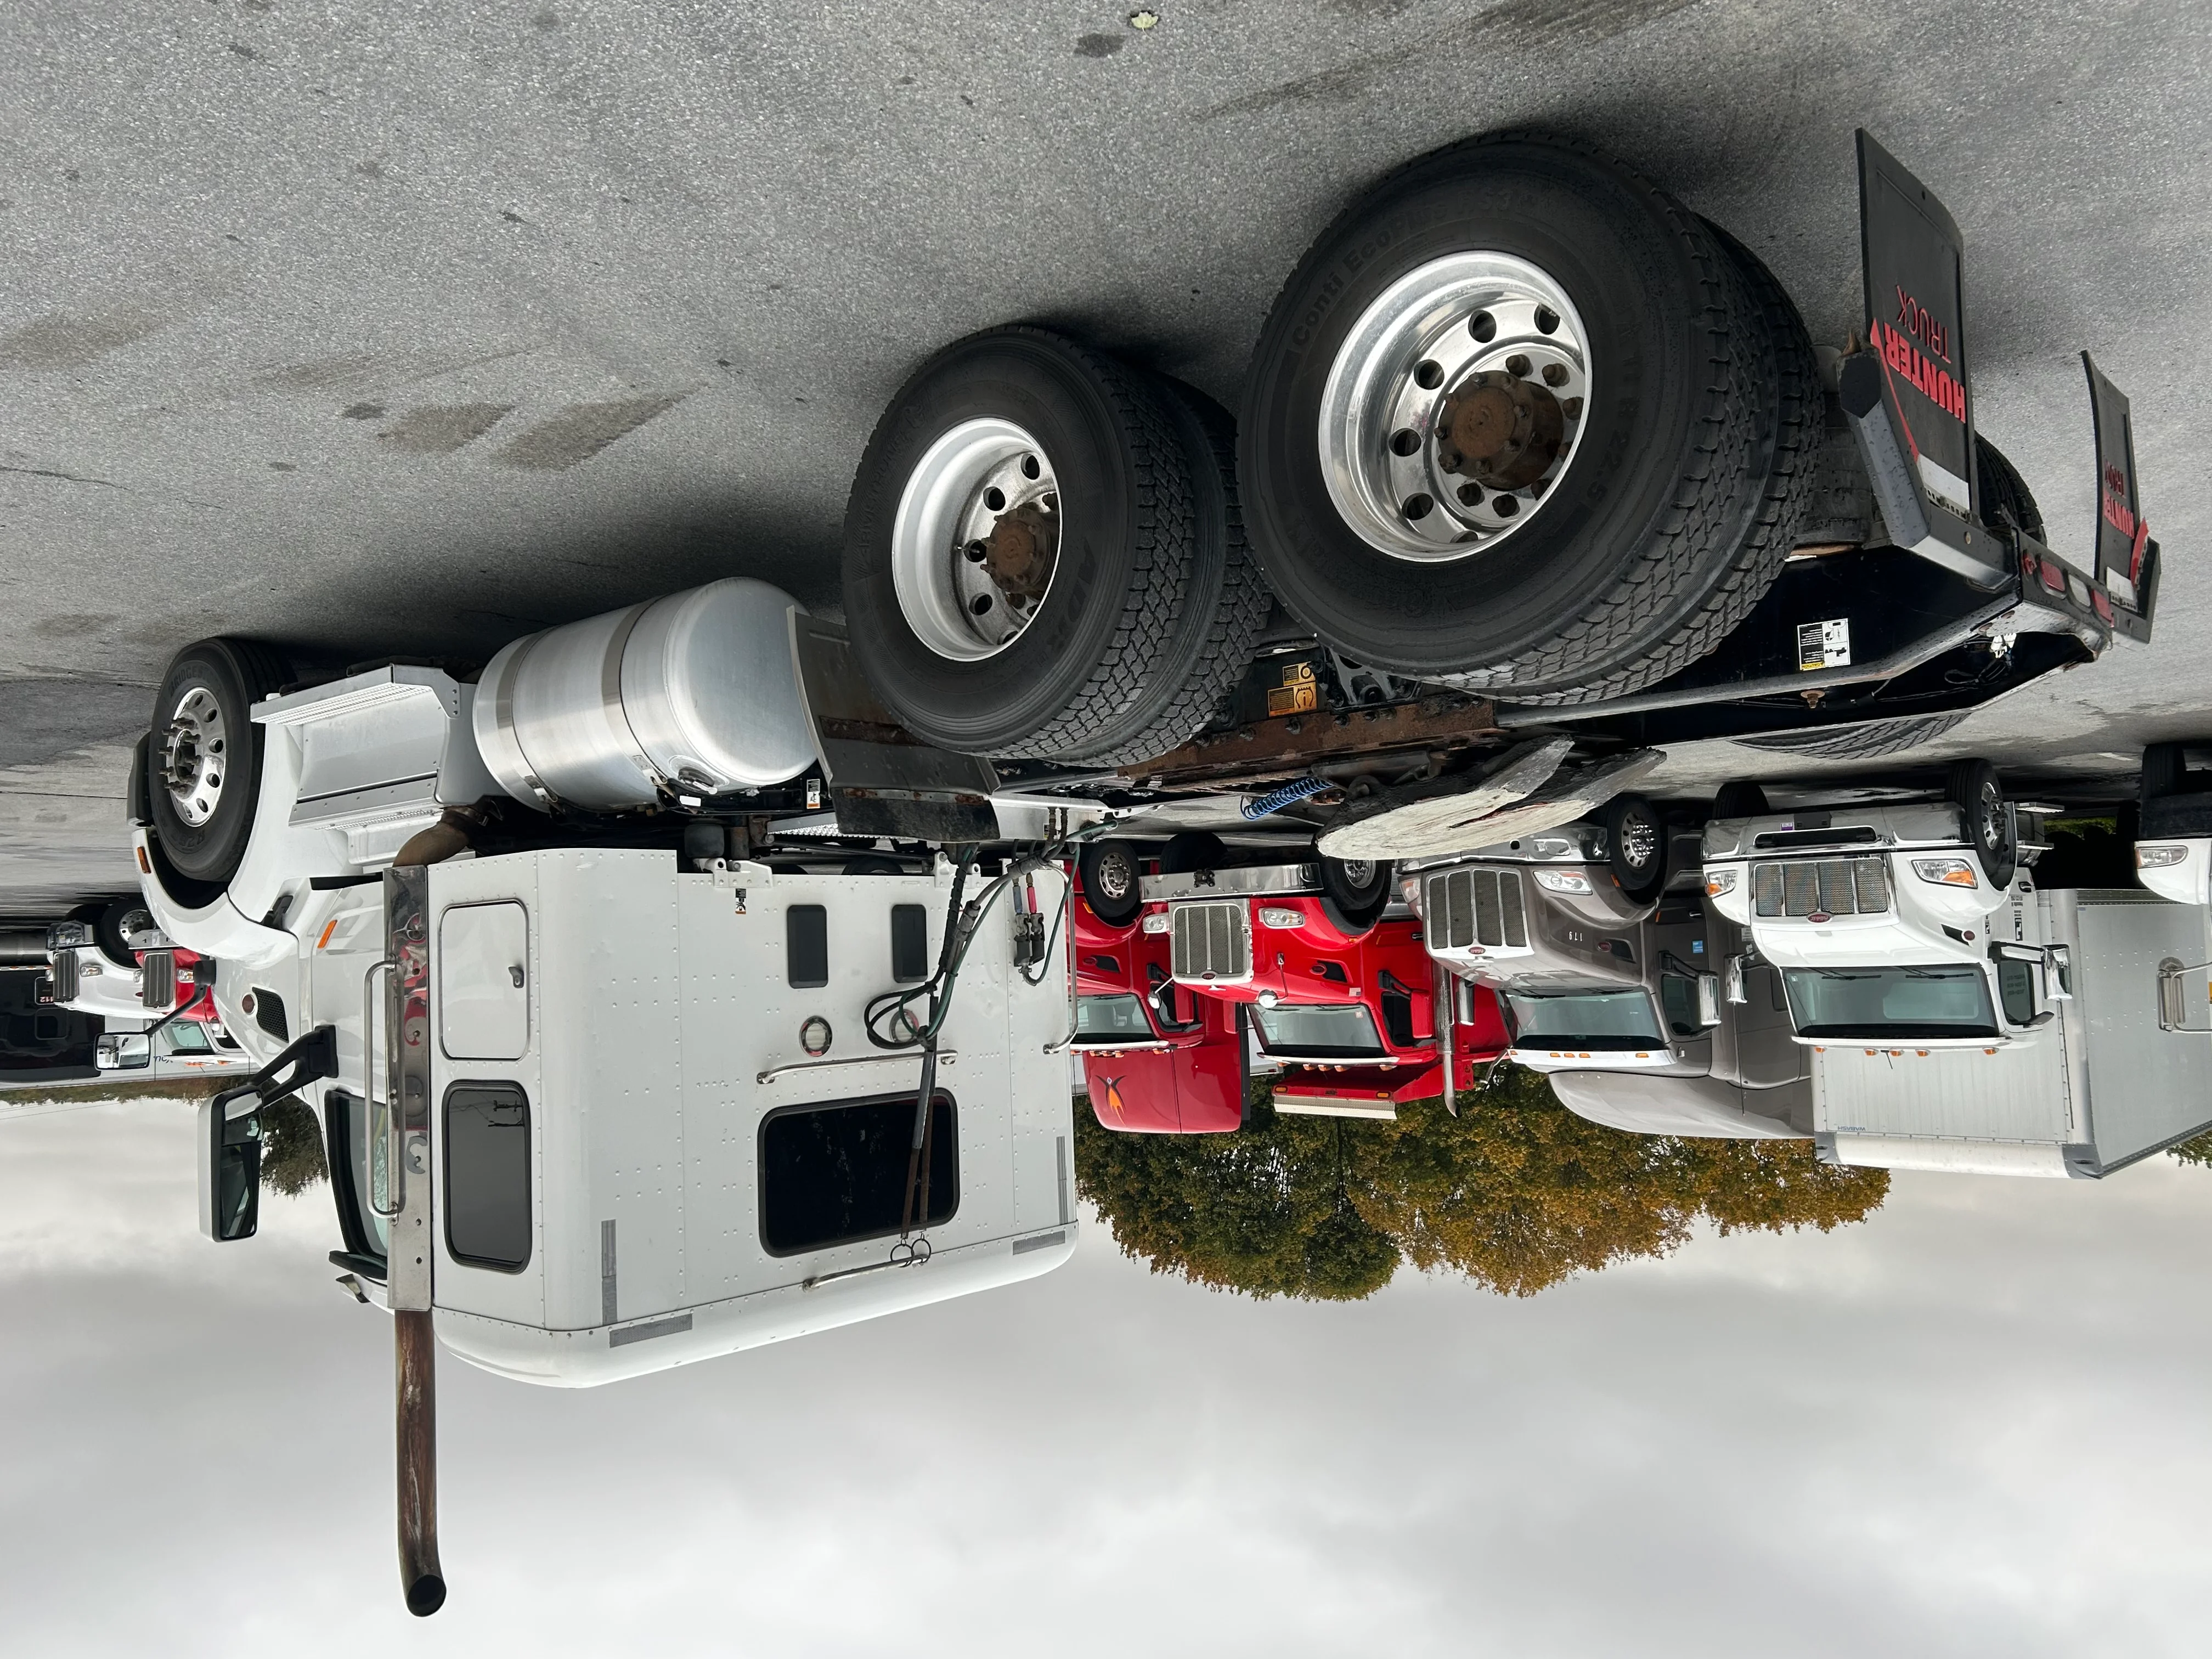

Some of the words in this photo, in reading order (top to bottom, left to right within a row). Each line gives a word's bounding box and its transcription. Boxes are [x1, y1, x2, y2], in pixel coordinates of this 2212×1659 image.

[1896, 285, 1951, 364] TRUCK
[1884, 323, 1966, 424] HUNTER
[1569, 931, 1583, 941] 179
